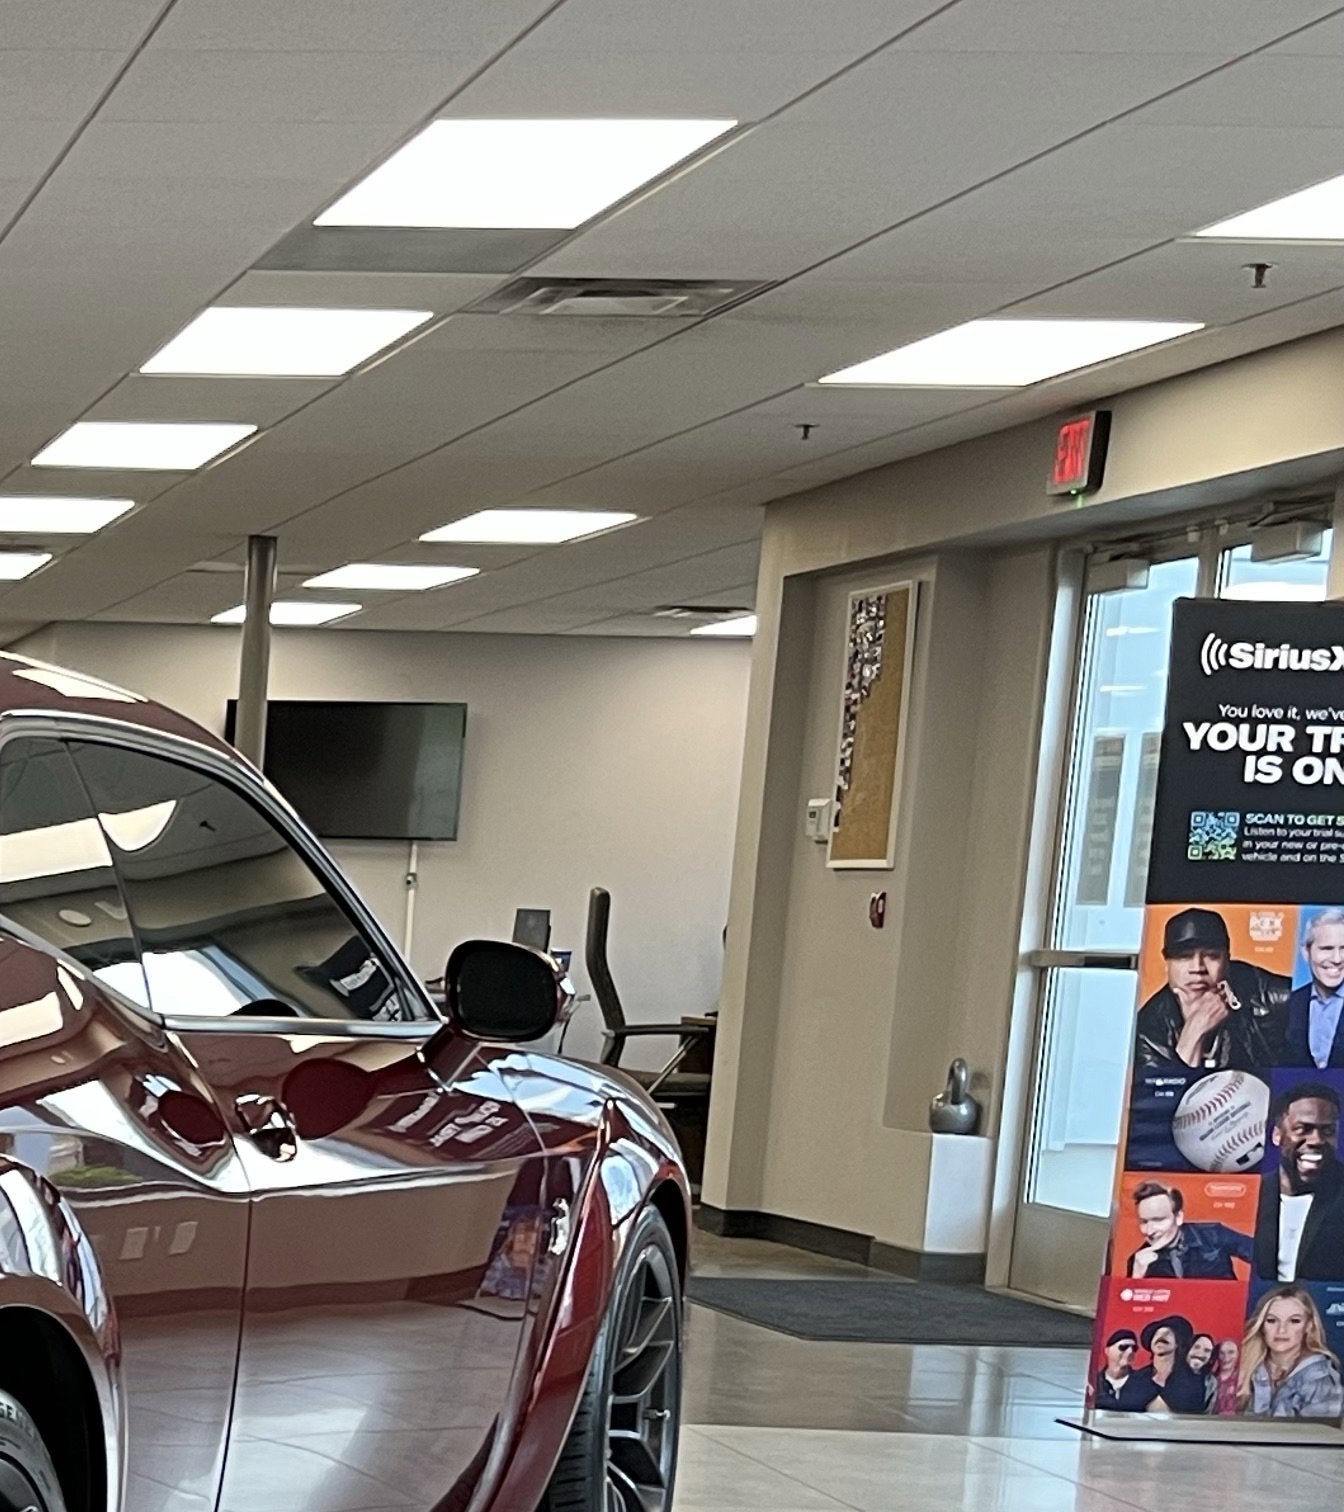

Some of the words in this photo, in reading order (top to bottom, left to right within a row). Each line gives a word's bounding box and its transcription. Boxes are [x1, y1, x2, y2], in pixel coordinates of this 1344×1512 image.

[1218, 703, 1249, 718] You
[1252, 703, 1284, 719] love
[1287, 705, 1301, 721] it,
[1183, 722, 1296, 752] YOUR
[1244, 754, 1283, 784] IS
[1292, 755, 1344, 785] ON
[1245, 813, 1285, 825] SCAN
[1287, 814, 1305, 825] TO
[1307, 815, 1335, 826] GET
[1244, 826, 1275, 837] Listen
[1276, 827, 1288, 837] to
[1289, 829, 1312, 839] your
[1255, 841, 1279, 851] your
[1281, 841, 1304, 849] new
[1305, 841, 1318, 850] or
[1279, 852, 1301, 862] and
[1302, 854, 1317, 863] on
[1319, 853, 1337, 863] the
